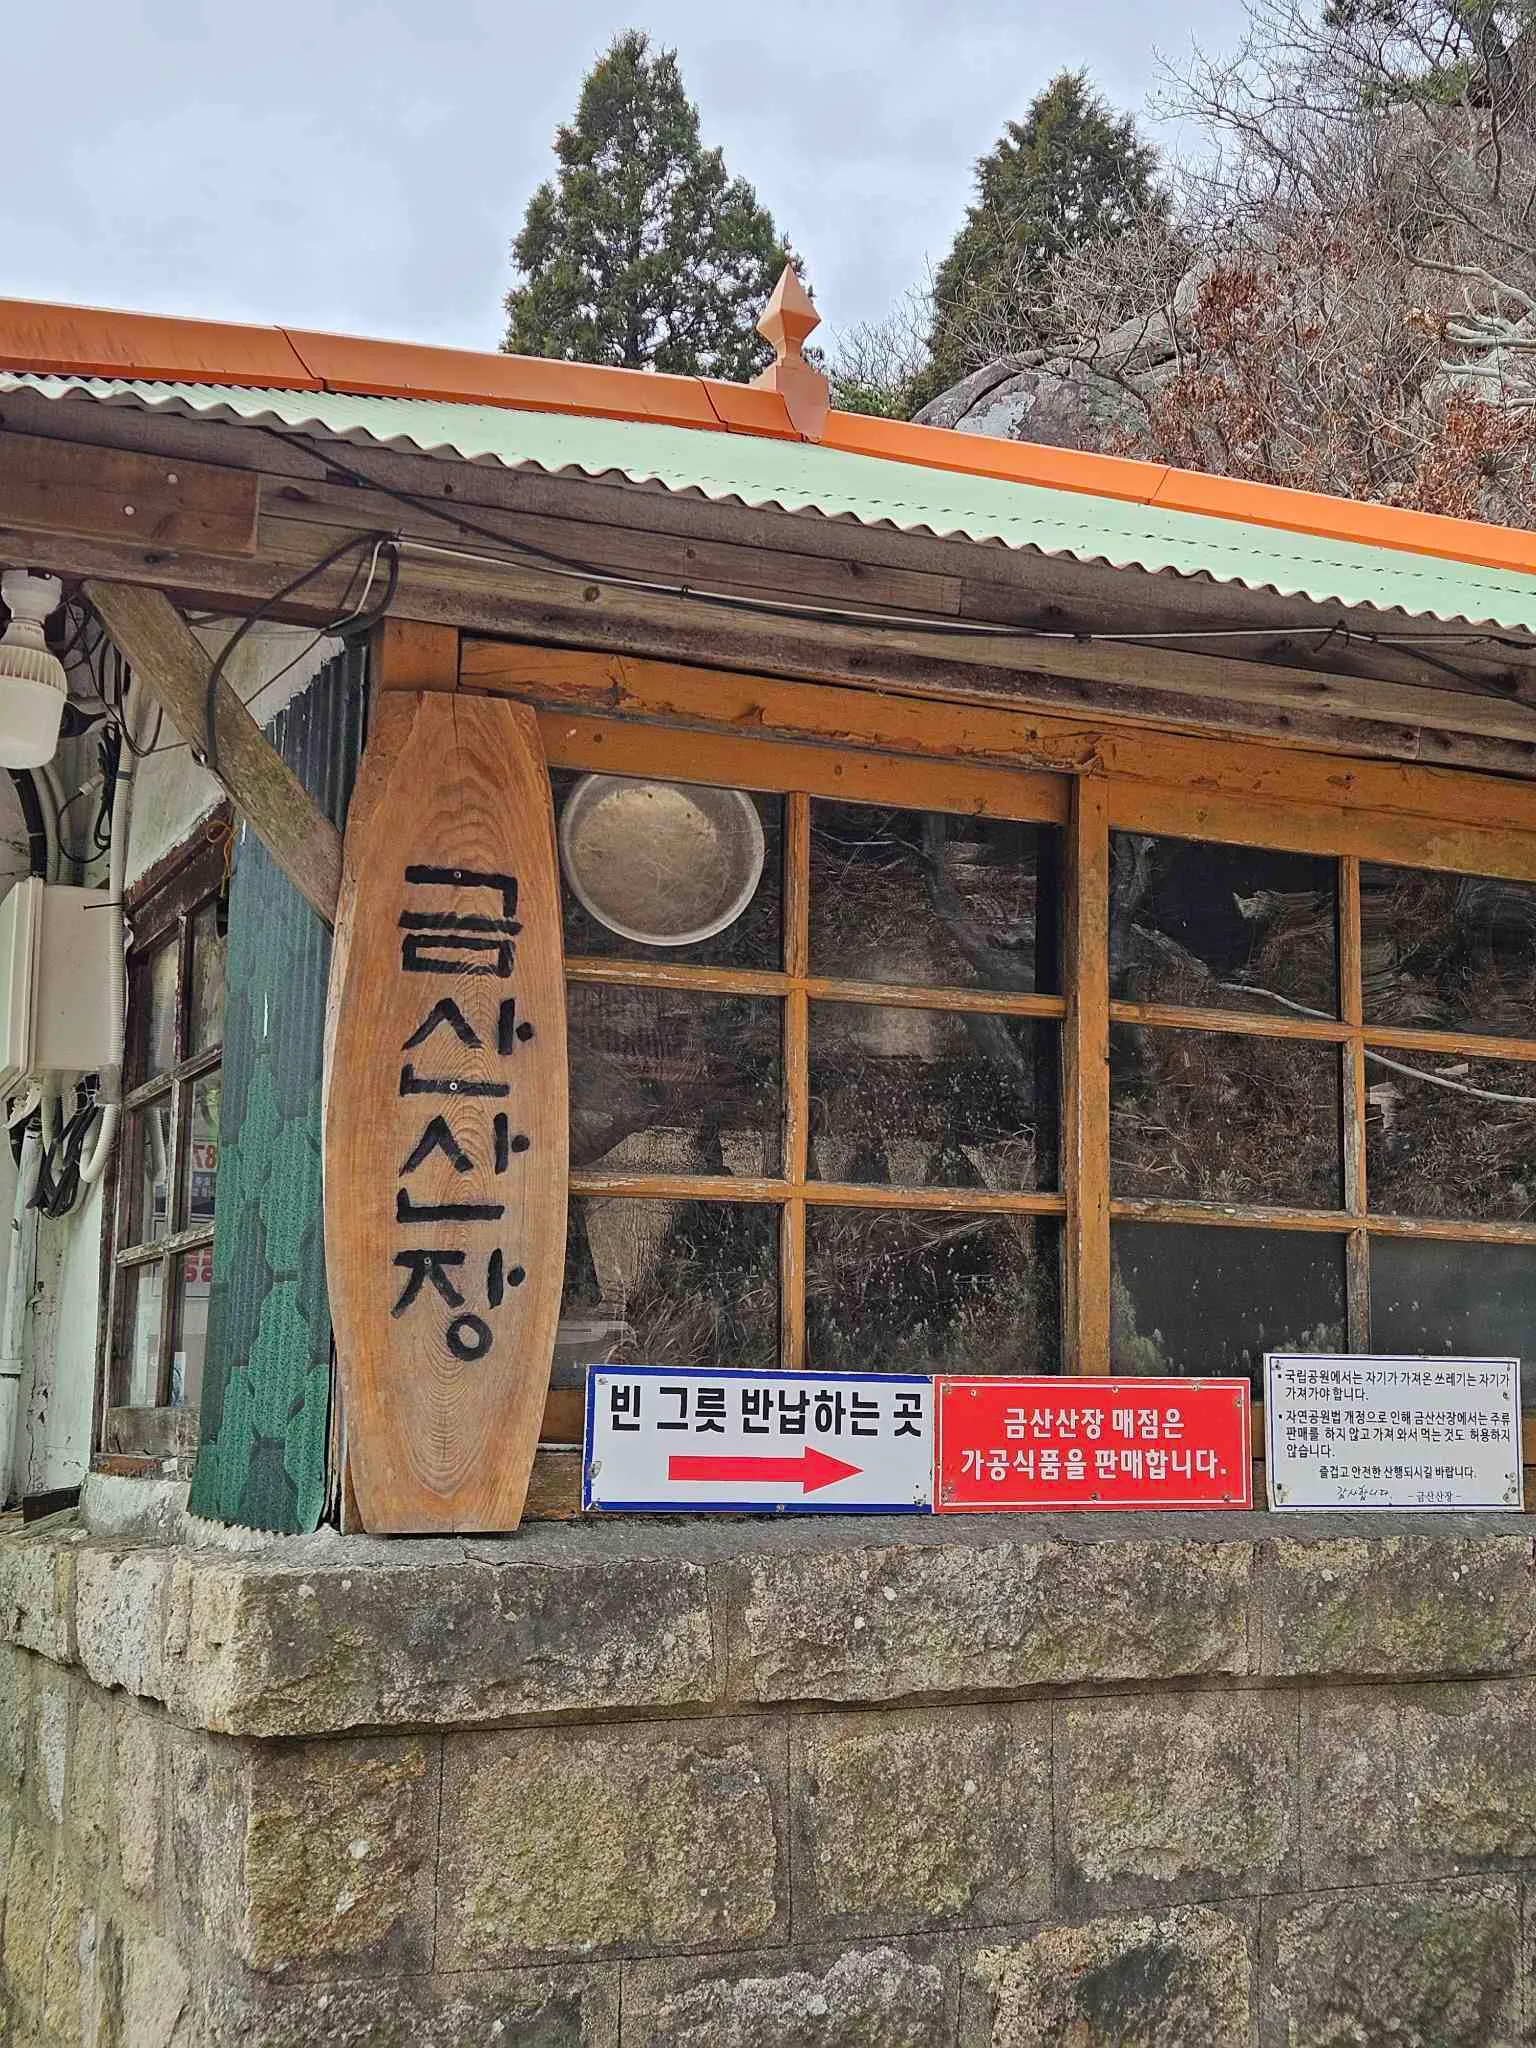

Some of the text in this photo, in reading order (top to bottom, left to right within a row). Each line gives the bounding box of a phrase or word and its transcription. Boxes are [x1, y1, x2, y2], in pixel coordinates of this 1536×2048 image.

[391, 864, 533, 1362] 금산산장
[1284, 1369, 1363, 1385] 국립공원에서는
[1365, 1370, 1398, 1385] 자기가
[1400, 1371, 1433, 1386] 가져온
[1479, 1373, 1510, 1388] 자기가
[1285, 1386, 1369, 1401] 가져가야 합니다.
[610, 1384, 924, 1438] 빈 그릇 반납하는 곳
[1286, 1409, 1511, 1426] 자연공원법 개정으로 인해 금산산장에서는 주류
[1004, 1407, 1186, 1440] 금산산장 매점은
[1286, 1426, 1319, 1441] 판매를
[1324, 1426, 1346, 1442] 하지
[1348, 1427, 1371, 1442] 않고
[1420, 1427, 1442, 1442] 먹는
[1444, 1428, 1465, 1442] 것도
[1469, 1428, 1510, 1443] 허용하지
[1286, 1443, 1335, 1458] 않습니다.
[961, 1448, 1227, 1481] 가공식품을 판매합니다.
[1319, 1465, 1349, 1479] 즐겁고
[1351, 1465, 1381, 1479] 안전한
[1383, 1465, 1433, 1479] 산행되시길
